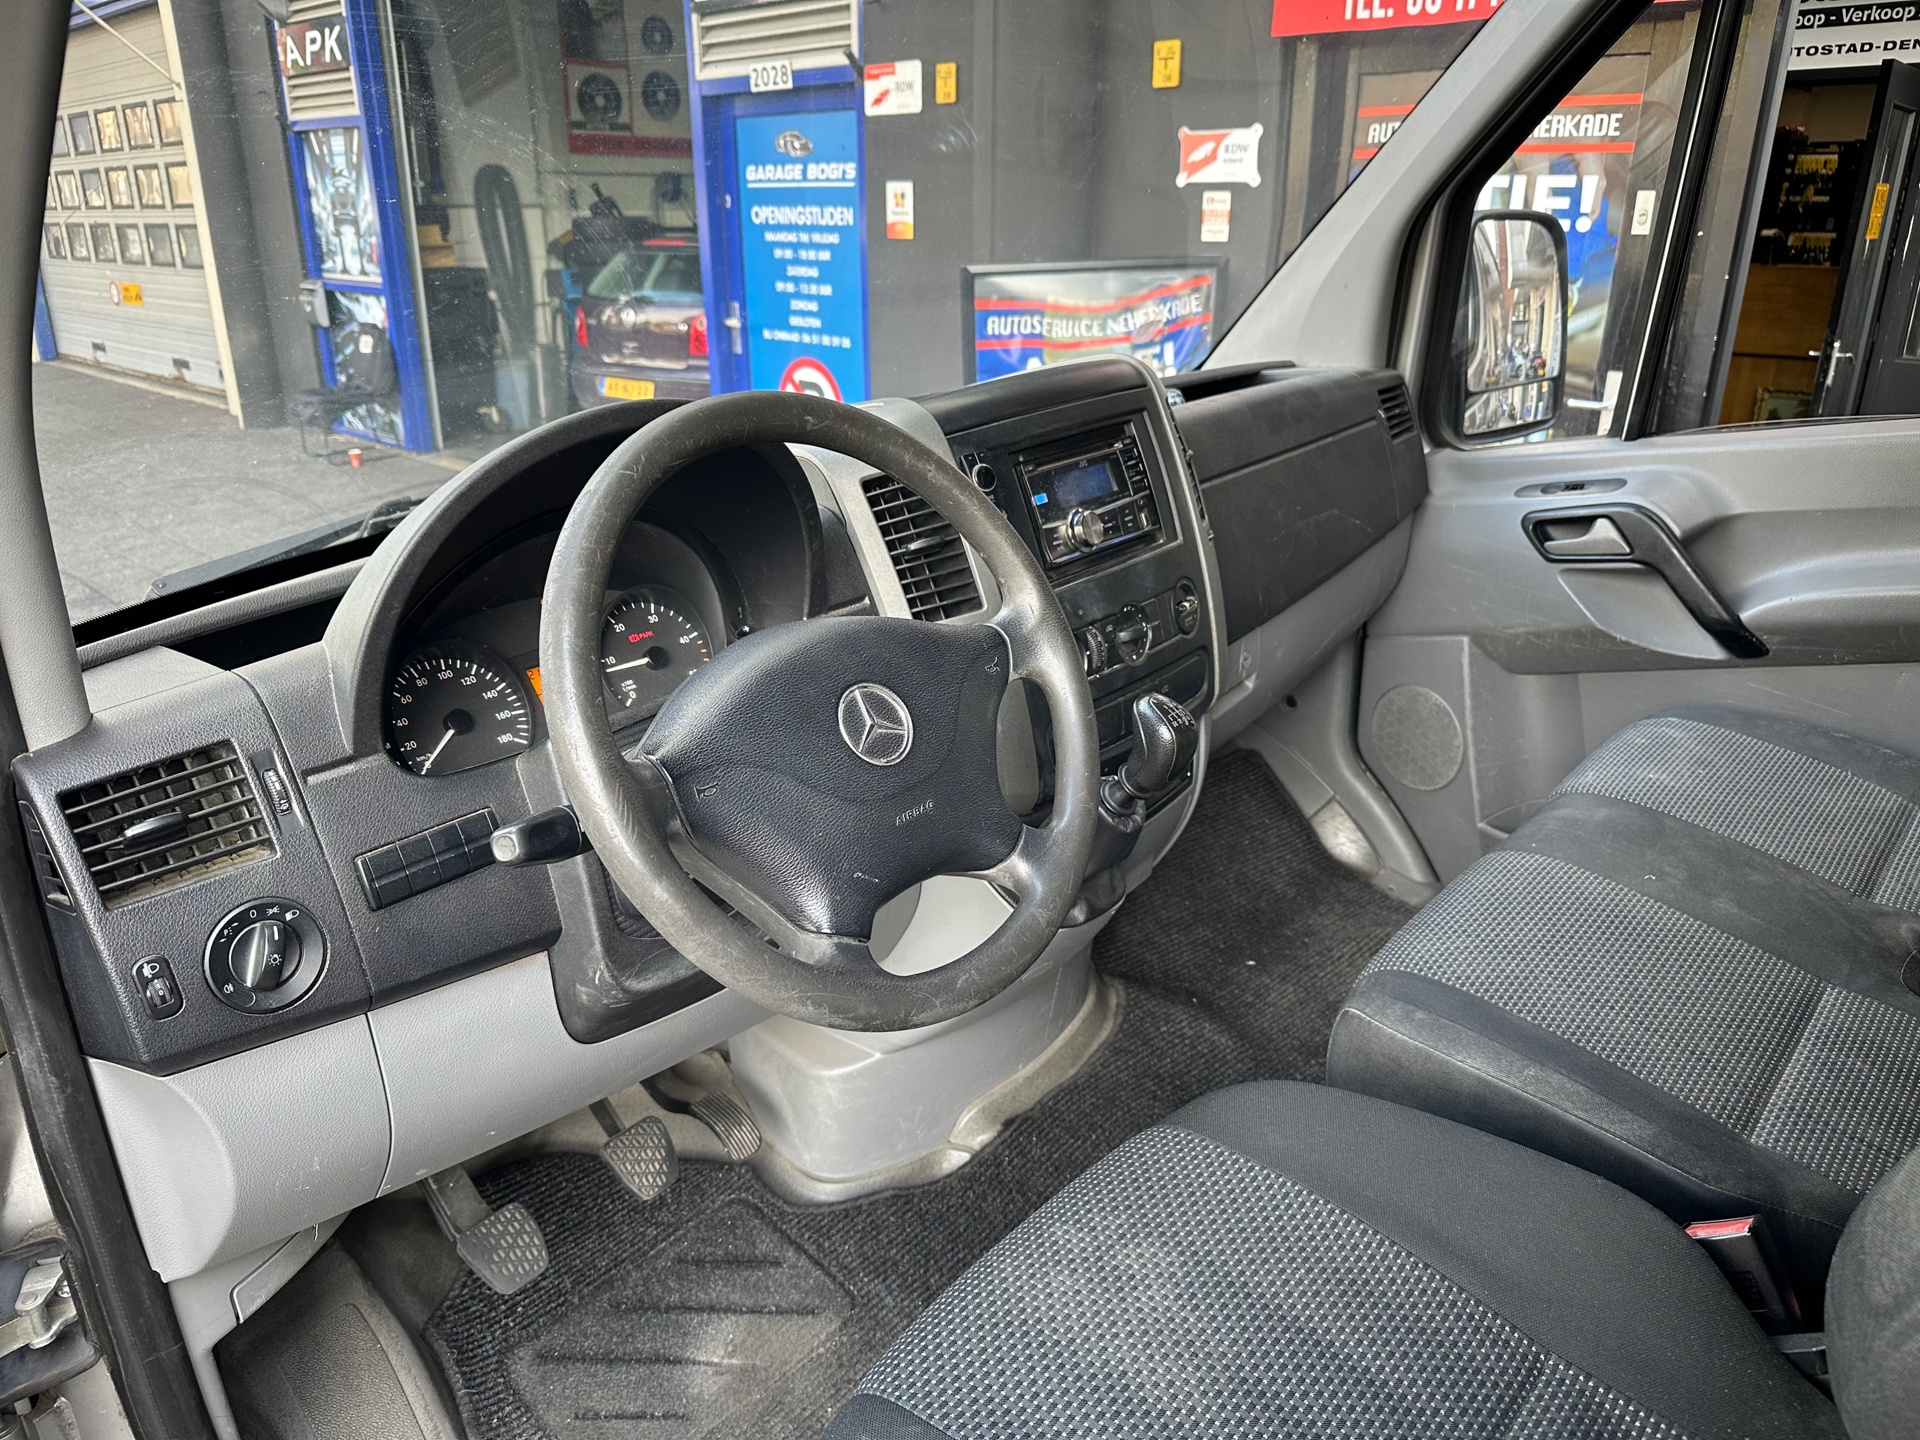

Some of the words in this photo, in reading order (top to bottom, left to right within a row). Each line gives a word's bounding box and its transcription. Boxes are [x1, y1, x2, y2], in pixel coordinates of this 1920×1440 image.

[1842, 5, 1916, 22] Verkoop
[286, 25, 343, 69] APK
[1790, 38, 1920, 57] TOSTAD-DEN
[751, 64, 789, 88] 2028
[745, 163, 804, 181] GARAGE
[806, 161, 857, 180] BOGI'S
[647, 613, 659, 624] 30
[614, 622, 626, 633] 20
[638, 630, 655, 641] PARK
[679, 635, 690, 645] 40
[605, 655, 616, 666] 10
[437, 669, 454, 681] 100
[460, 675, 477, 686] 120
[415, 677, 428, 687] 80
[401, 694, 413, 704] 60
[482, 689, 499, 700] 140
[495, 709, 512, 721] 160
[396, 717, 409, 727] 40
[496, 732, 513, 744] 180
[404, 739, 417, 750] 20
[896, 799, 935, 826] AIRBAG
